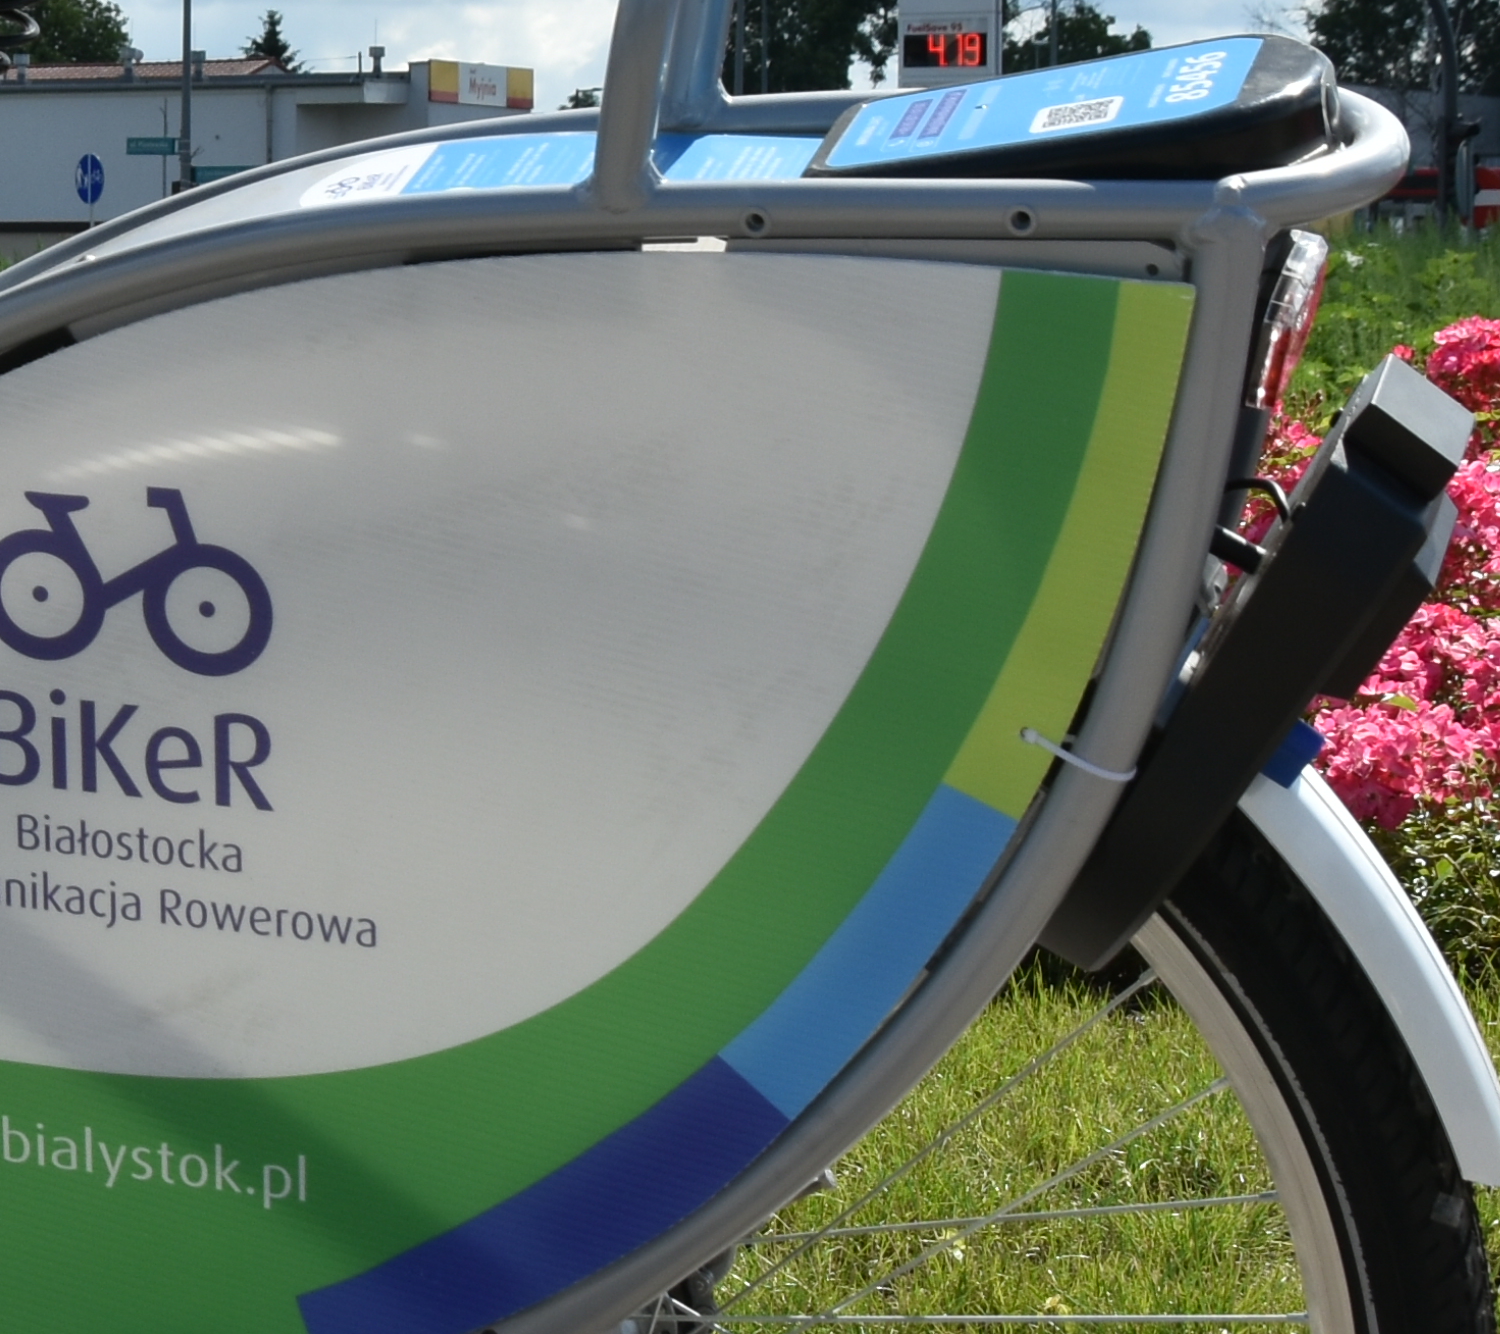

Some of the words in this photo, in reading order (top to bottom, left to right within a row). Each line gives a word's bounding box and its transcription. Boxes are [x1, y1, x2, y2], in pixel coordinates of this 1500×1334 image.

[906, 23, 948, 33] FuelSave
[951, 22, 963, 31] 95
[468, 76, 498, 100] Myjnia
[1164, 51, 1228, 103] 85456
[15, 813, 244, 874] Białostocka
[158, 886, 379, 950] Rowerowa
